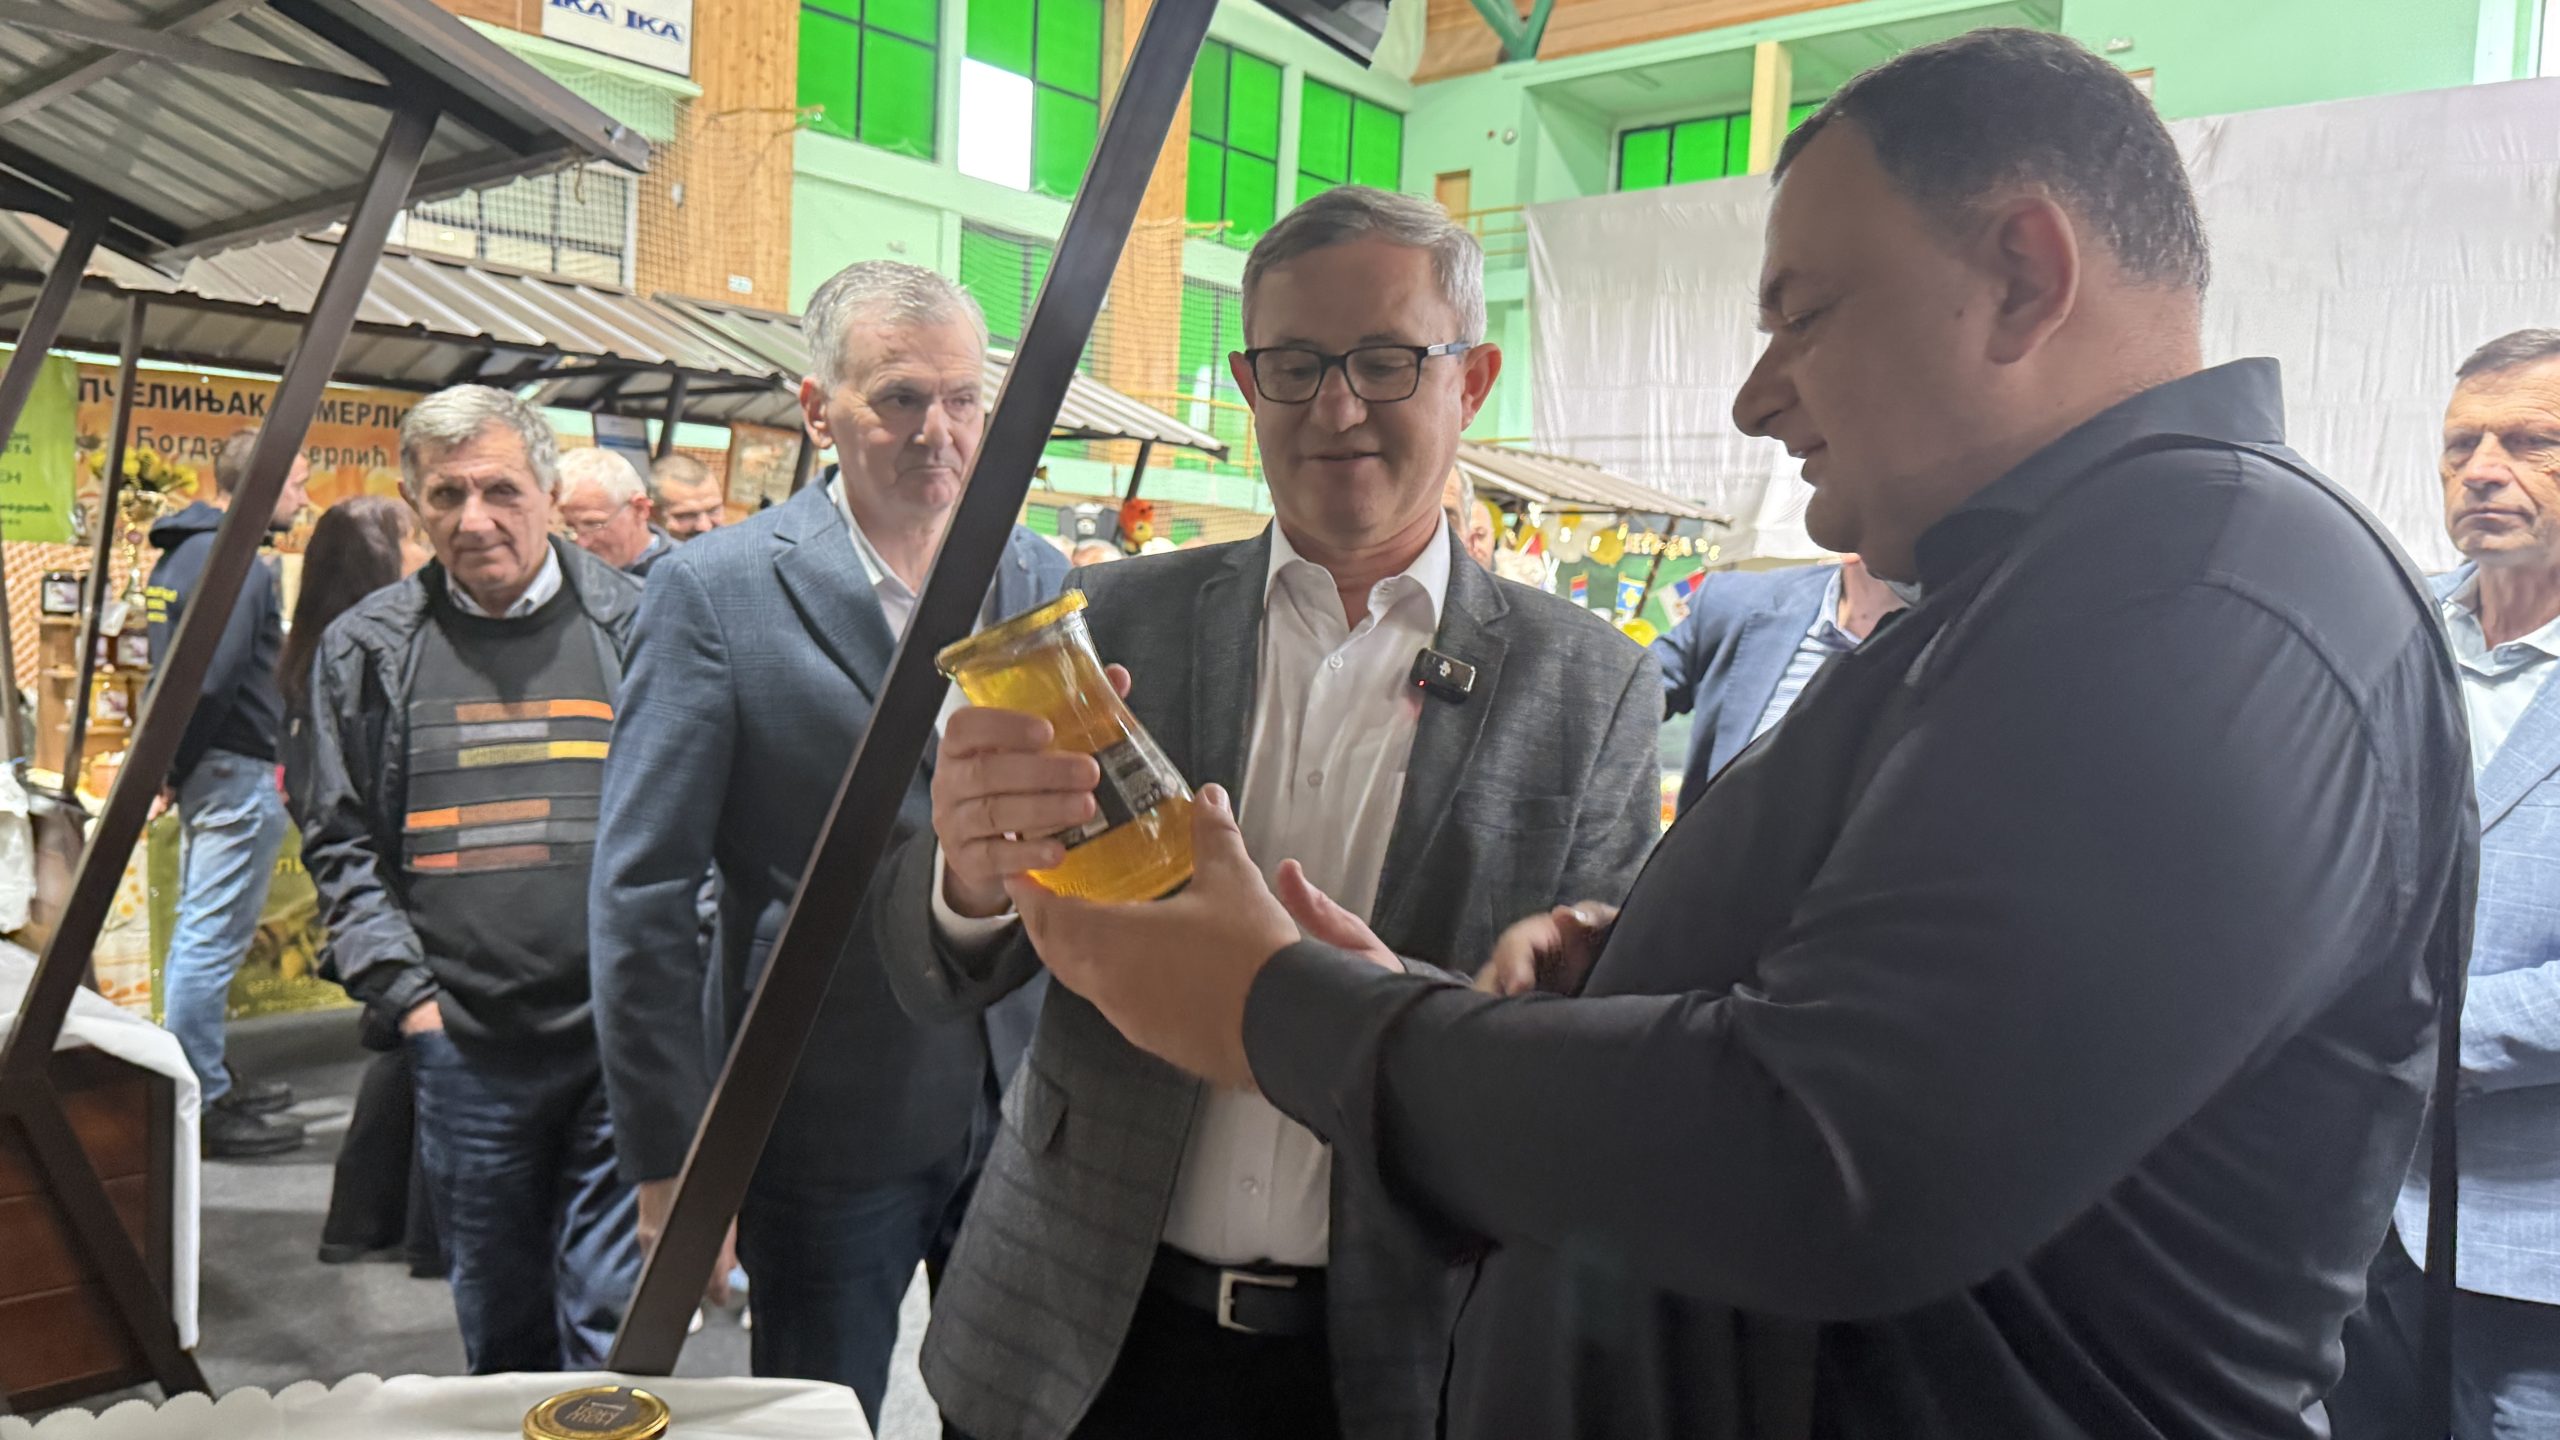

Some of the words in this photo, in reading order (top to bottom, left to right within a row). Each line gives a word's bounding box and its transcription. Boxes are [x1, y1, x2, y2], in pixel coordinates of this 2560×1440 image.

[626, 9, 682, 43] IKA
[136, 426, 226, 460] Богда
[308, 444, 388, 471] ерлић
